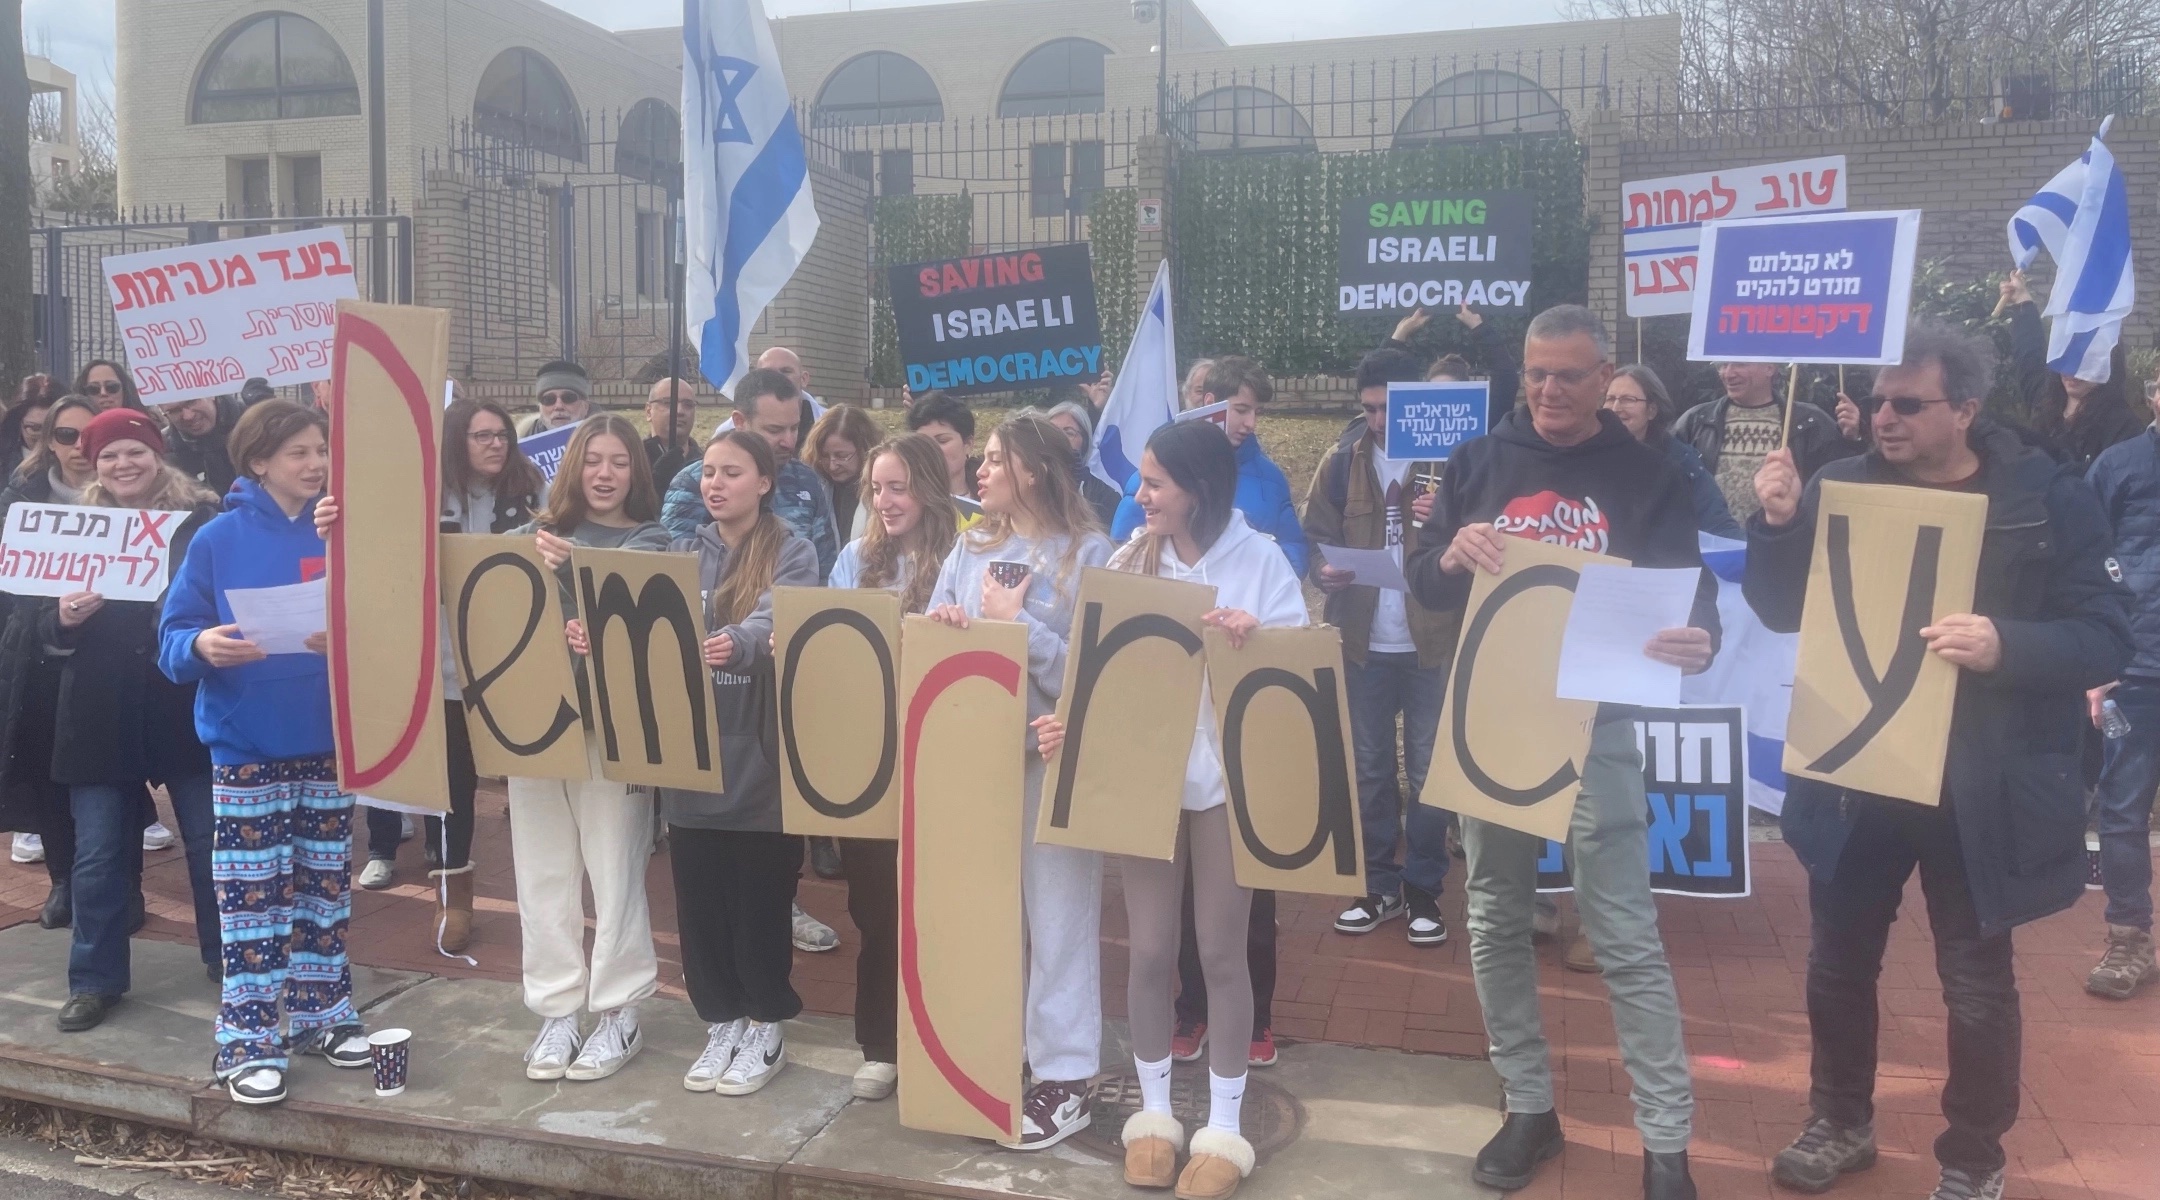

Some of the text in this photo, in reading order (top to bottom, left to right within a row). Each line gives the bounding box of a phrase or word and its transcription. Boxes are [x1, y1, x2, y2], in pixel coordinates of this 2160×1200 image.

[1623, 168, 1838, 229] טוב למחות
[1369, 199, 1487, 228] SAVING
[1367, 235, 1497, 264] ISRAELI
[1748, 248, 1853, 275] לא קבלתם
[111, 240, 353, 311] בעד מנהיגות
[919, 252, 1045, 298] SAVING
[1736, 275, 1861, 299] מנדט להקים
[1339, 279, 1531, 311] DEMOCRACY
[932, 295, 1074, 342] ISRAELI
[1718, 303, 1873, 339] דיקטטורה
[906, 345, 1102, 393] DEMOCRACY
[1404, 402, 1471, 418] ישראלים
[1440, 415, 1478, 433] למען
[1411, 431, 1462, 447] ישראל
[19, 509, 111, 538] מנדט
